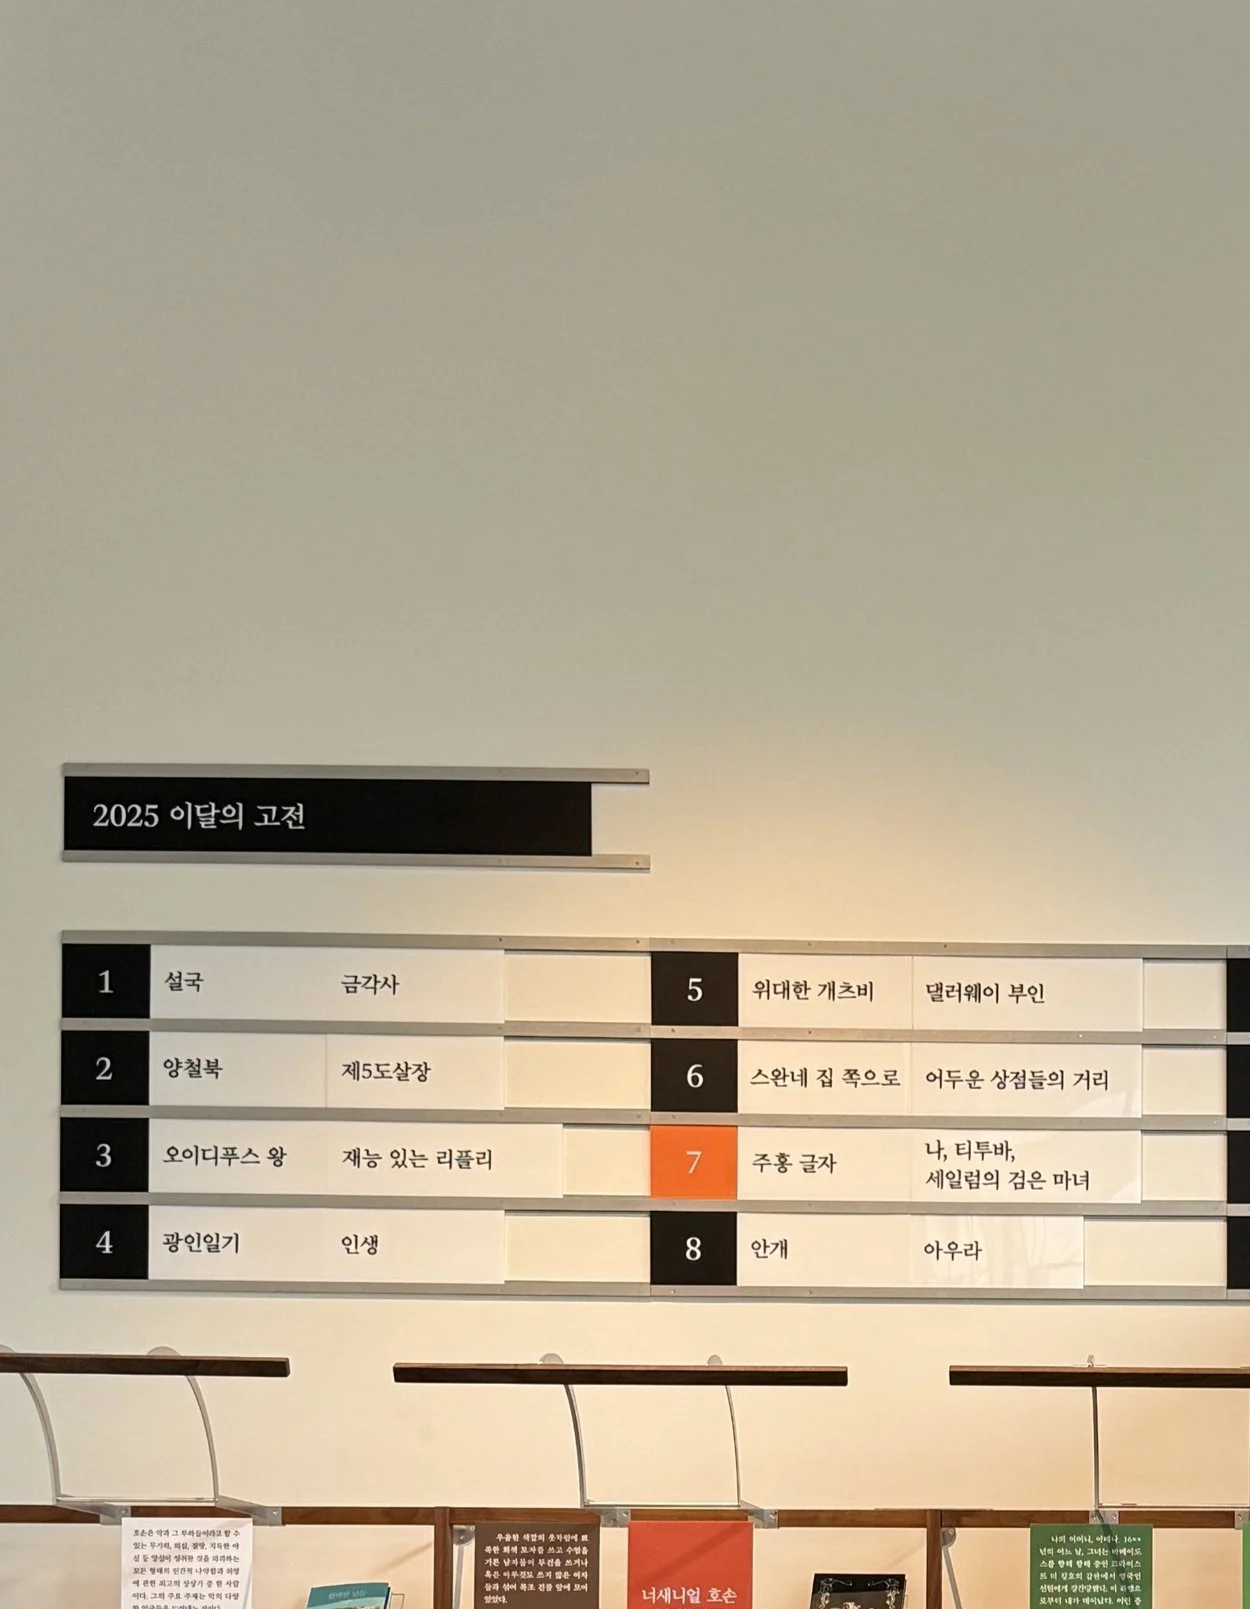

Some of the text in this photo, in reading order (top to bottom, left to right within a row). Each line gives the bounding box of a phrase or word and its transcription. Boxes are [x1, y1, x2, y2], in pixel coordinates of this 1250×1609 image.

[92, 801, 306, 831] 2025 이달의 고전
[99, 969, 114, 994] 1
[164, 970, 205, 993] 설국
[340, 973, 400, 996] 금각사
[687, 977, 703, 1002] 5
[752, 978, 874, 1003] 위대한 개츠비
[925, 981, 1045, 1005] 댈러웨이 부인
[95, 1056, 113, 1081] 2
[162, 1057, 224, 1080] 양철북
[341, 1060, 432, 1083] 제5도살장
[686, 1064, 704, 1088] 6
[750, 1066, 901, 1089] 스완네 집 쪽으로
[925, 1068, 1109, 1092] 어두운 상점들의 거리
[95, 1143, 112, 1168] 3
[162, 1144, 288, 1168] 오이디푸스 왕
[342, 1146, 492, 1171] 재능 있는 리플리
[686, 1150, 703, 1174] 7
[925, 1139, 1016, 1163] 나, 티투바,
[752, 1152, 838, 1175] 주홍 글자
[925, 1168, 1090, 1192] 세일럼의 검은 마녀
[95, 1230, 113, 1254] 4
[162, 1231, 240, 1255] 광인일기
[341, 1233, 379, 1256] 인생
[685, 1236, 702, 1261] 8
[750, 1238, 788, 1260] 안개
[923, 1240, 983, 1262] 아우라
[641, 1586, 738, 1605] 너새니얼 호손
